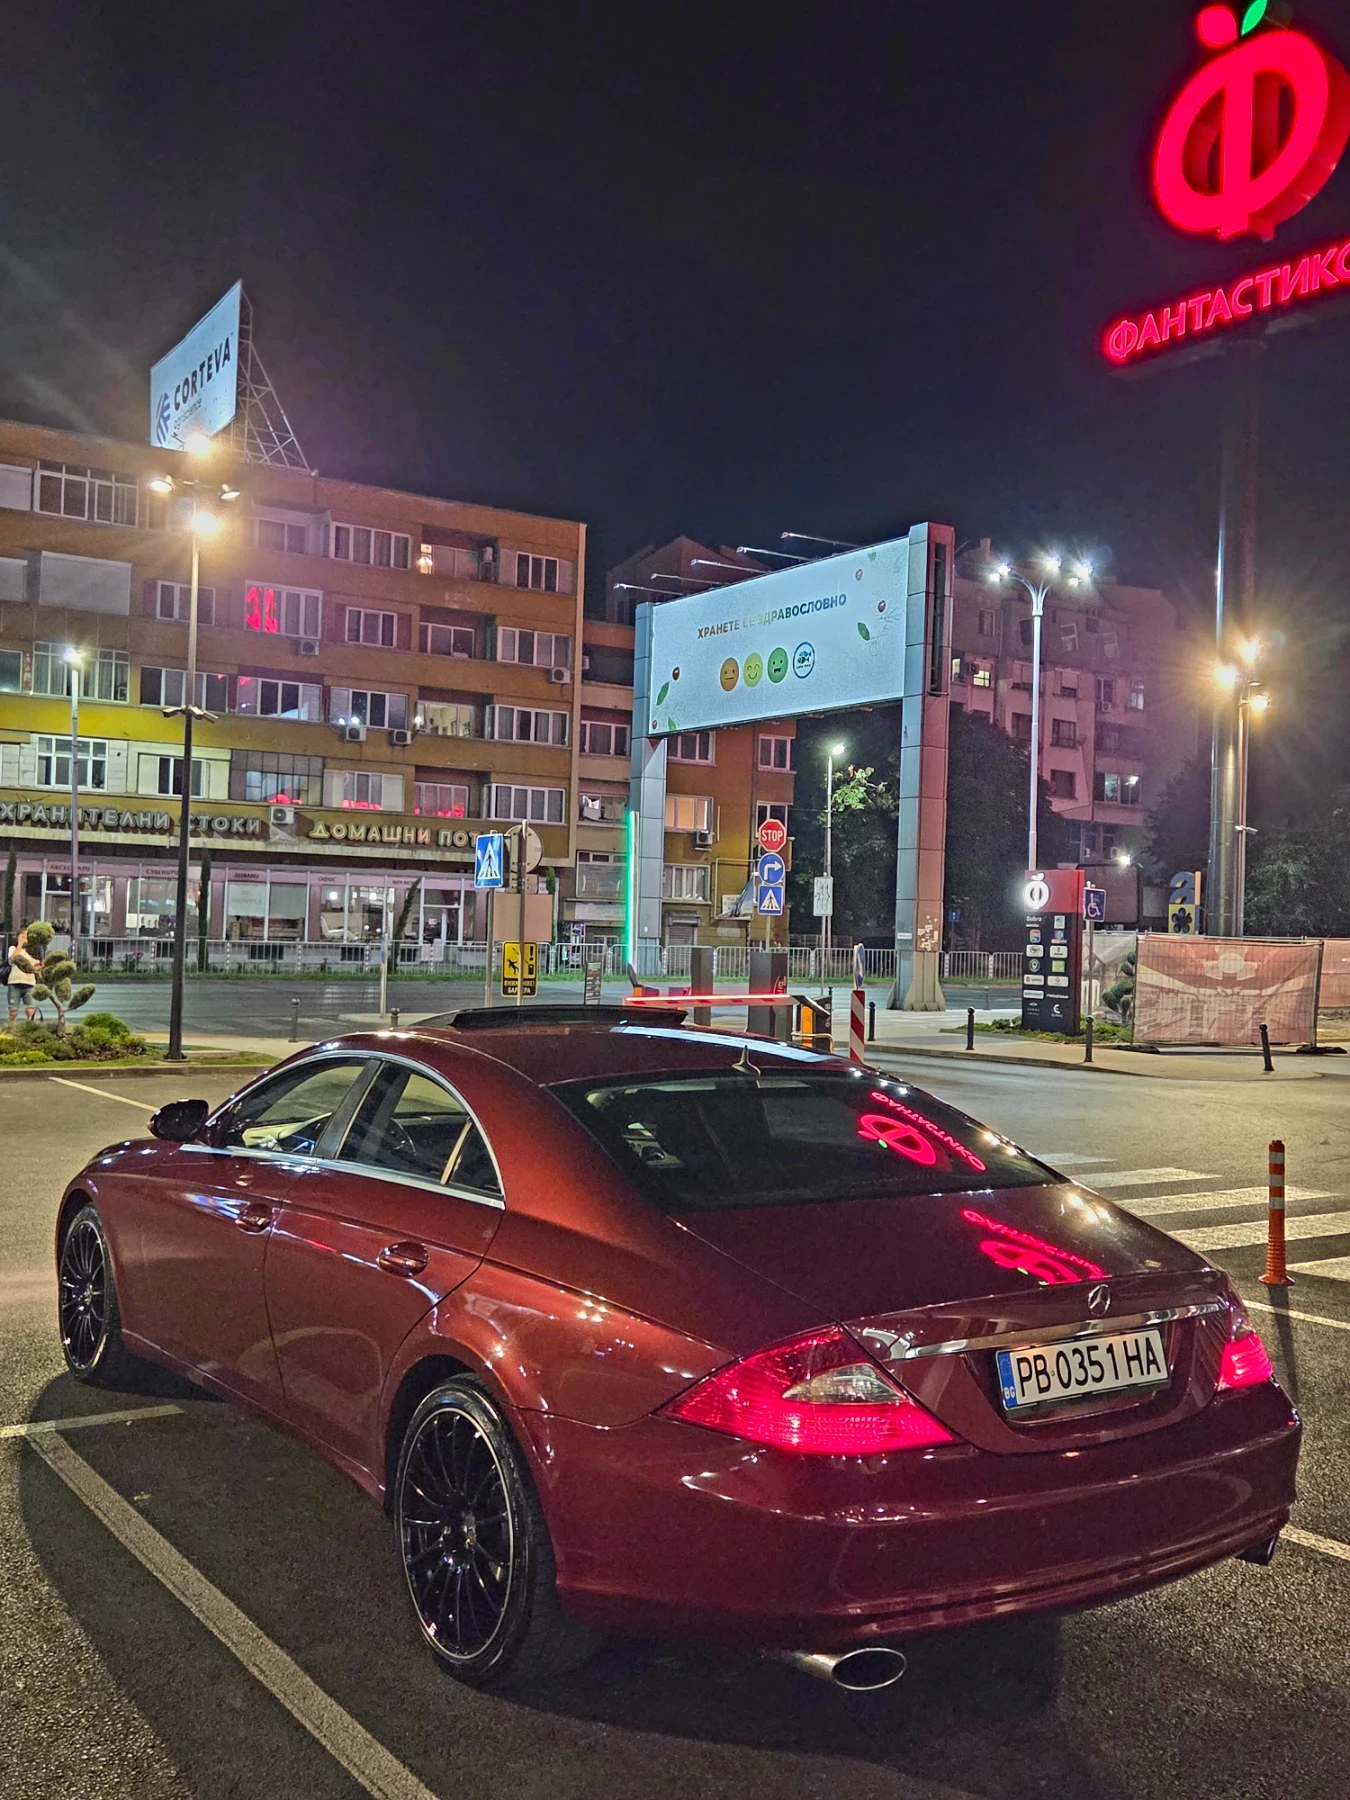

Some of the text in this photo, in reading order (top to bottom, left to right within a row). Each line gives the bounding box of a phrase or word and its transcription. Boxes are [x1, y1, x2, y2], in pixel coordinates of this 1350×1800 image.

[173, 336, 231, 412] CORTEVA
[697, 593, 847, 639] ХРАНЕТЕ СЕ ЗДРАВОСЛОВНО
[309, 820, 431, 846] ДОМАШНИ
[761, 830, 783, 842] STOP
[1016, 1336, 1162, 1397] PB 0351 HA
[1003, 1386, 1016, 1400] BG
